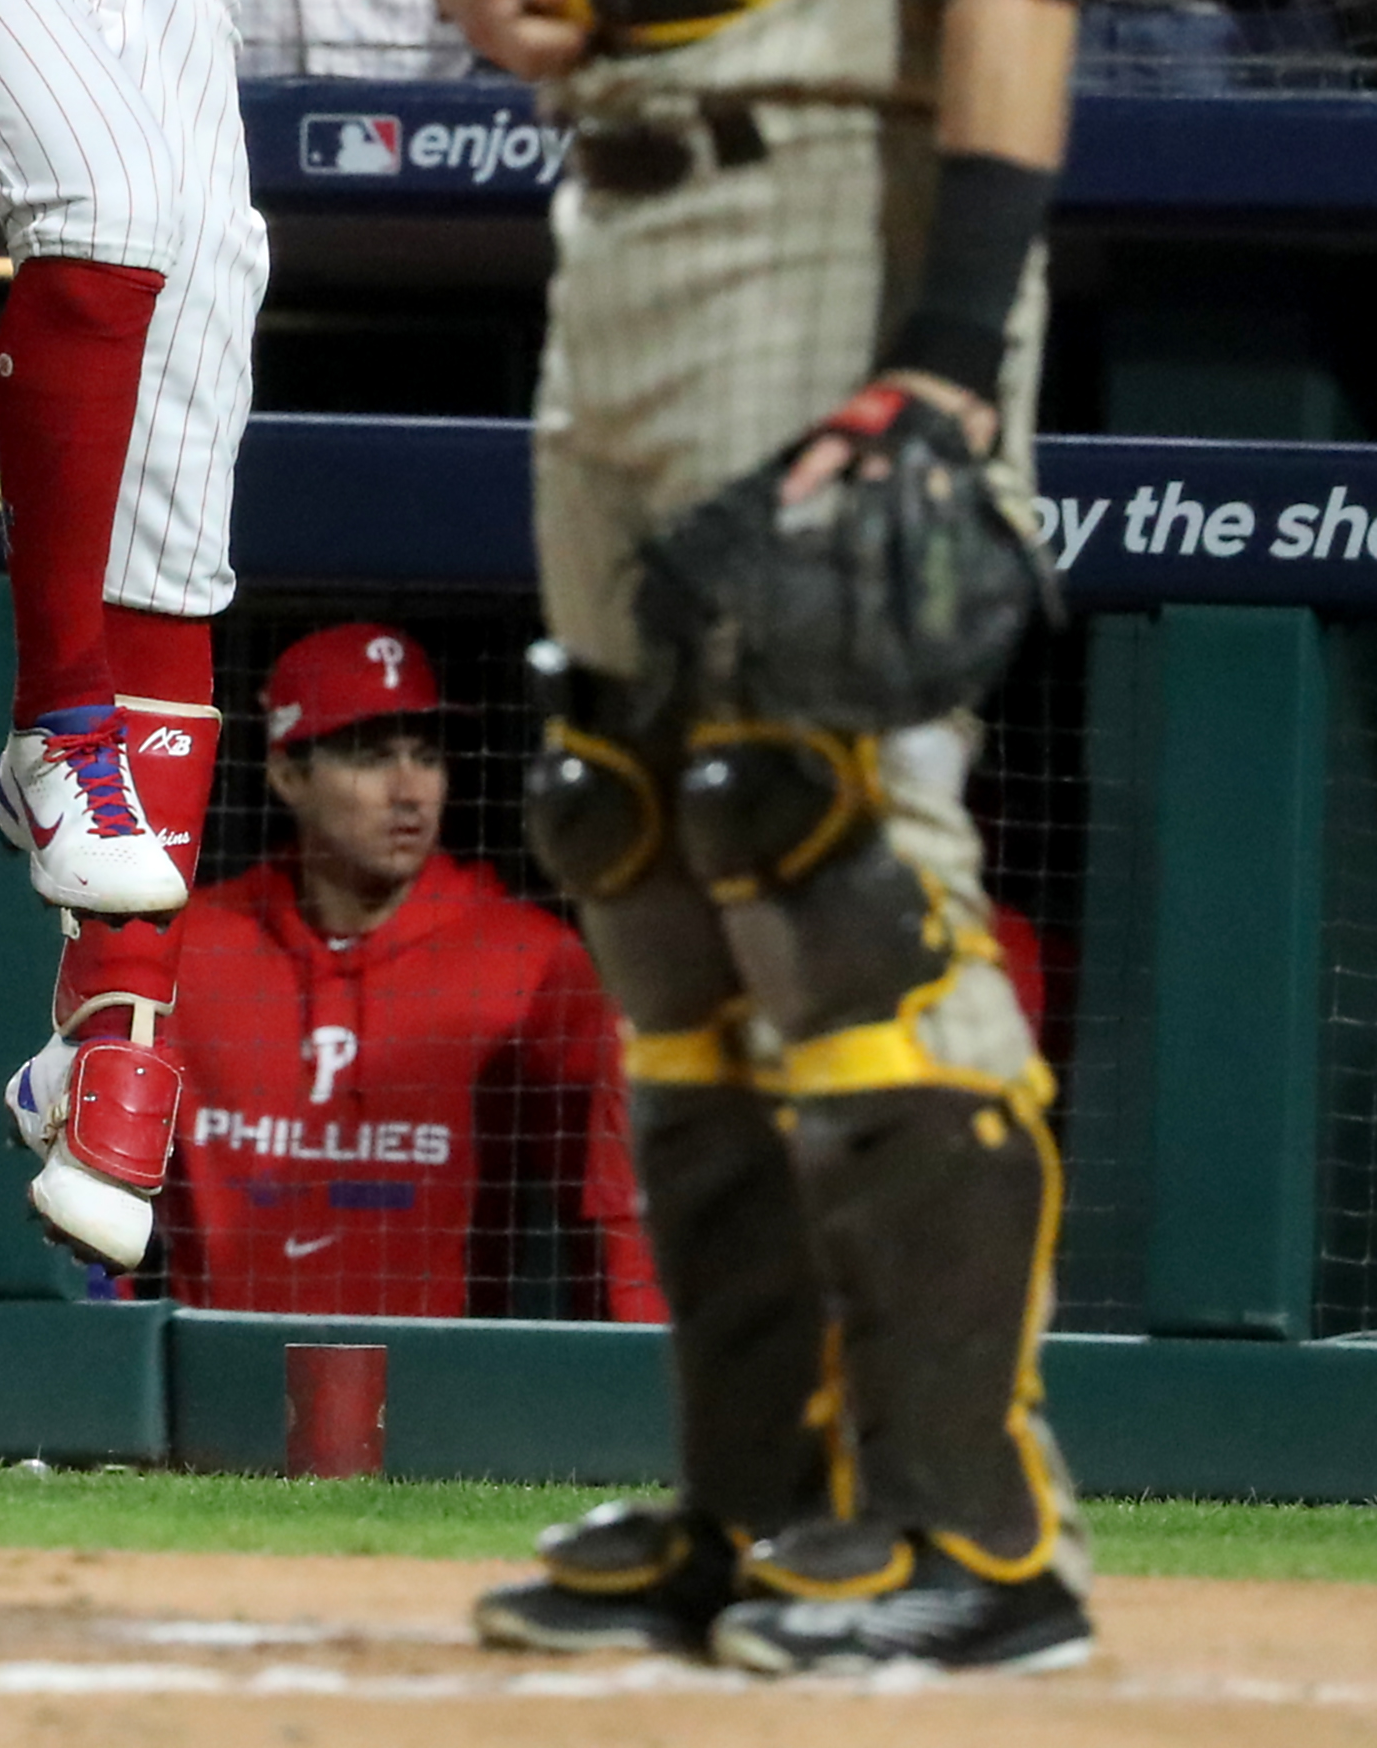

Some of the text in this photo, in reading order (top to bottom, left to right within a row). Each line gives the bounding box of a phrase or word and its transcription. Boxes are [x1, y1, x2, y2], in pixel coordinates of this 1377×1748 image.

[1124, 480, 1255, 558] the
[367, 636, 404, 688] P
[301, 1025, 358, 1104] P
[194, 1107, 450, 1164] PHILLIES
